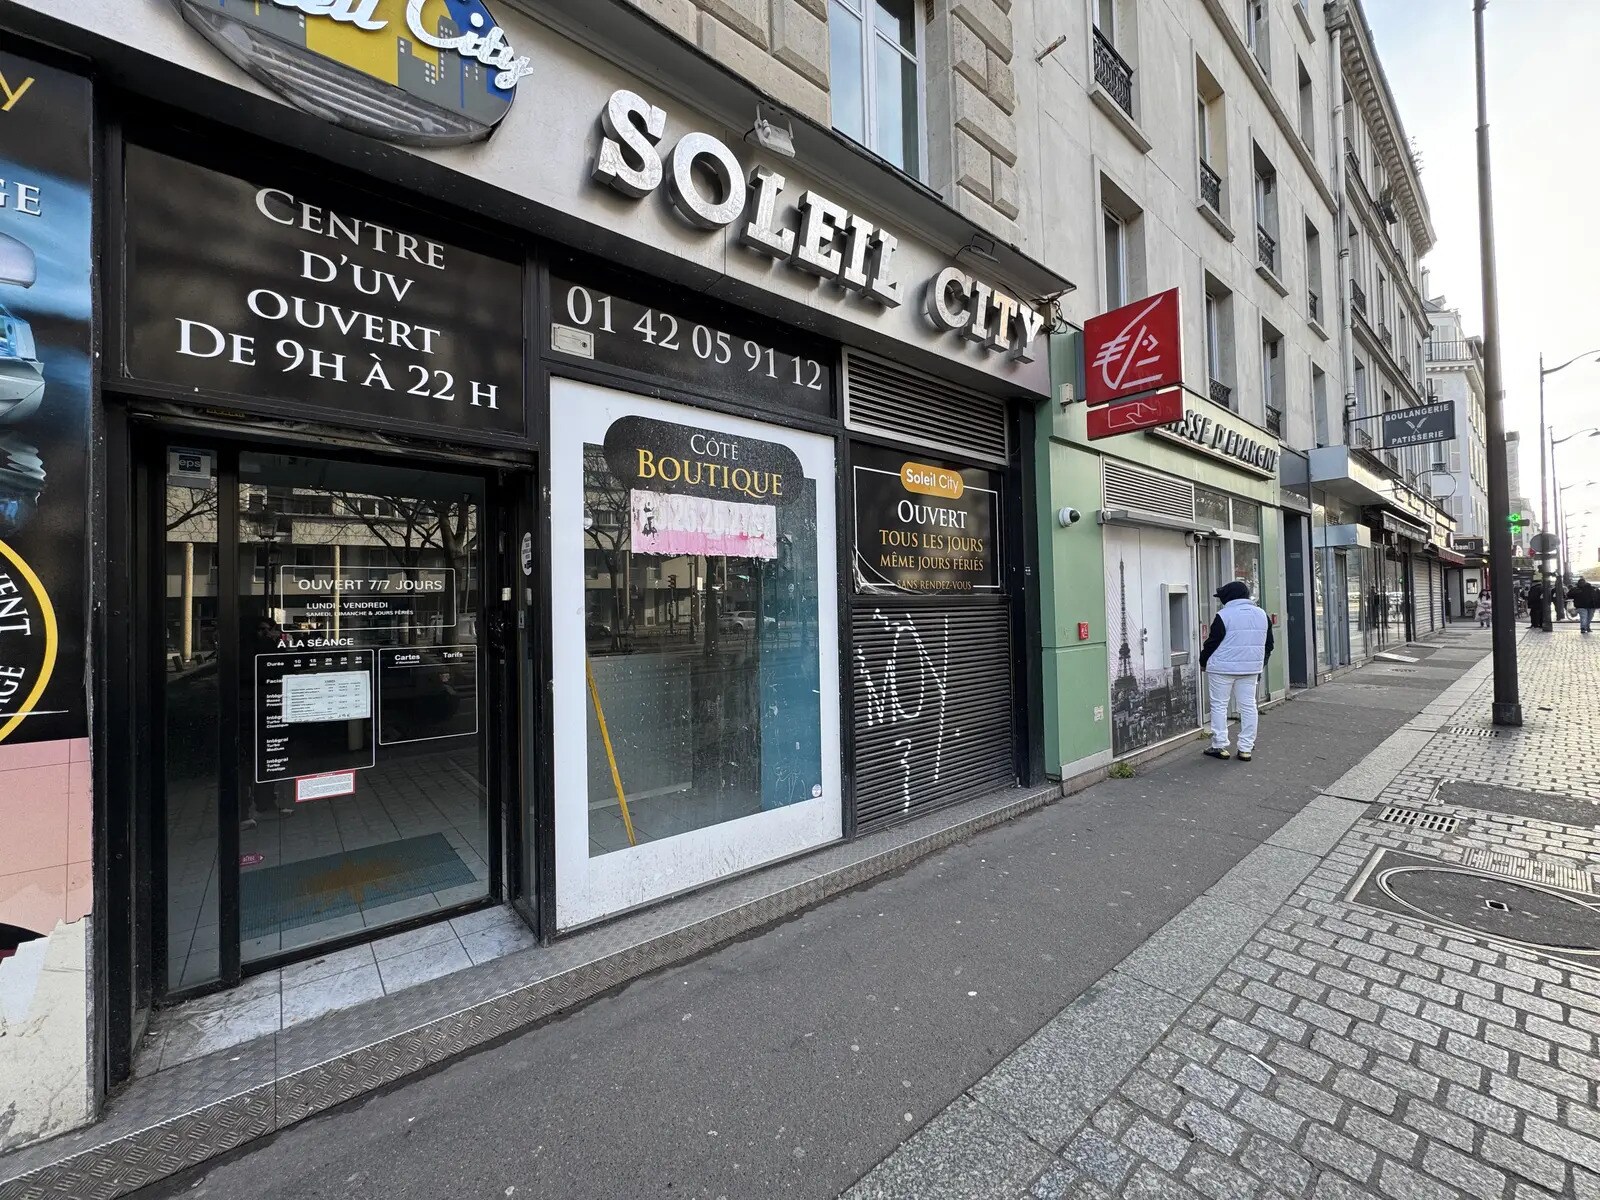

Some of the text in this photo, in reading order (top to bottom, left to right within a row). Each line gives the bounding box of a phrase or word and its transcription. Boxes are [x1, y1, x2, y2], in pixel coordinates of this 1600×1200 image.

[255, 188, 446, 271] CENTRE
[591, 89, 1045, 365] SOLEIL CITY
[299, 249, 415, 302] D'UV
[247, 289, 441, 354] OUVERT
[567, 285, 824, 391] 01 42 05 91 12
[175, 317, 499, 410] DE 9H À 22 H
[1385, 403, 1450, 422] BOULANGERIE
[690, 433, 739, 462] CÔTÉ
[1391, 430, 1445, 445] PATISSERIE
[179, 459, 201, 469] eps
[636, 448, 784, 499] BOUTIQUE
[905, 468, 960, 494] Soleil City
[896, 499, 968, 530] OUVERT
[878, 529, 984, 554] TOUS LES JOURS
[879, 550, 985, 572] MÊME JOURS FÉRIÉS
[298, 578, 443, 592] OUVERT 7/7 JOURS
[920, 579, 973, 591] RENDEZ-VOUS
[306, 602, 336, 610] LUNDI
[342, 601, 389, 609] VENDREDI
[277, 636, 355, 648] À LA SÉANCE
